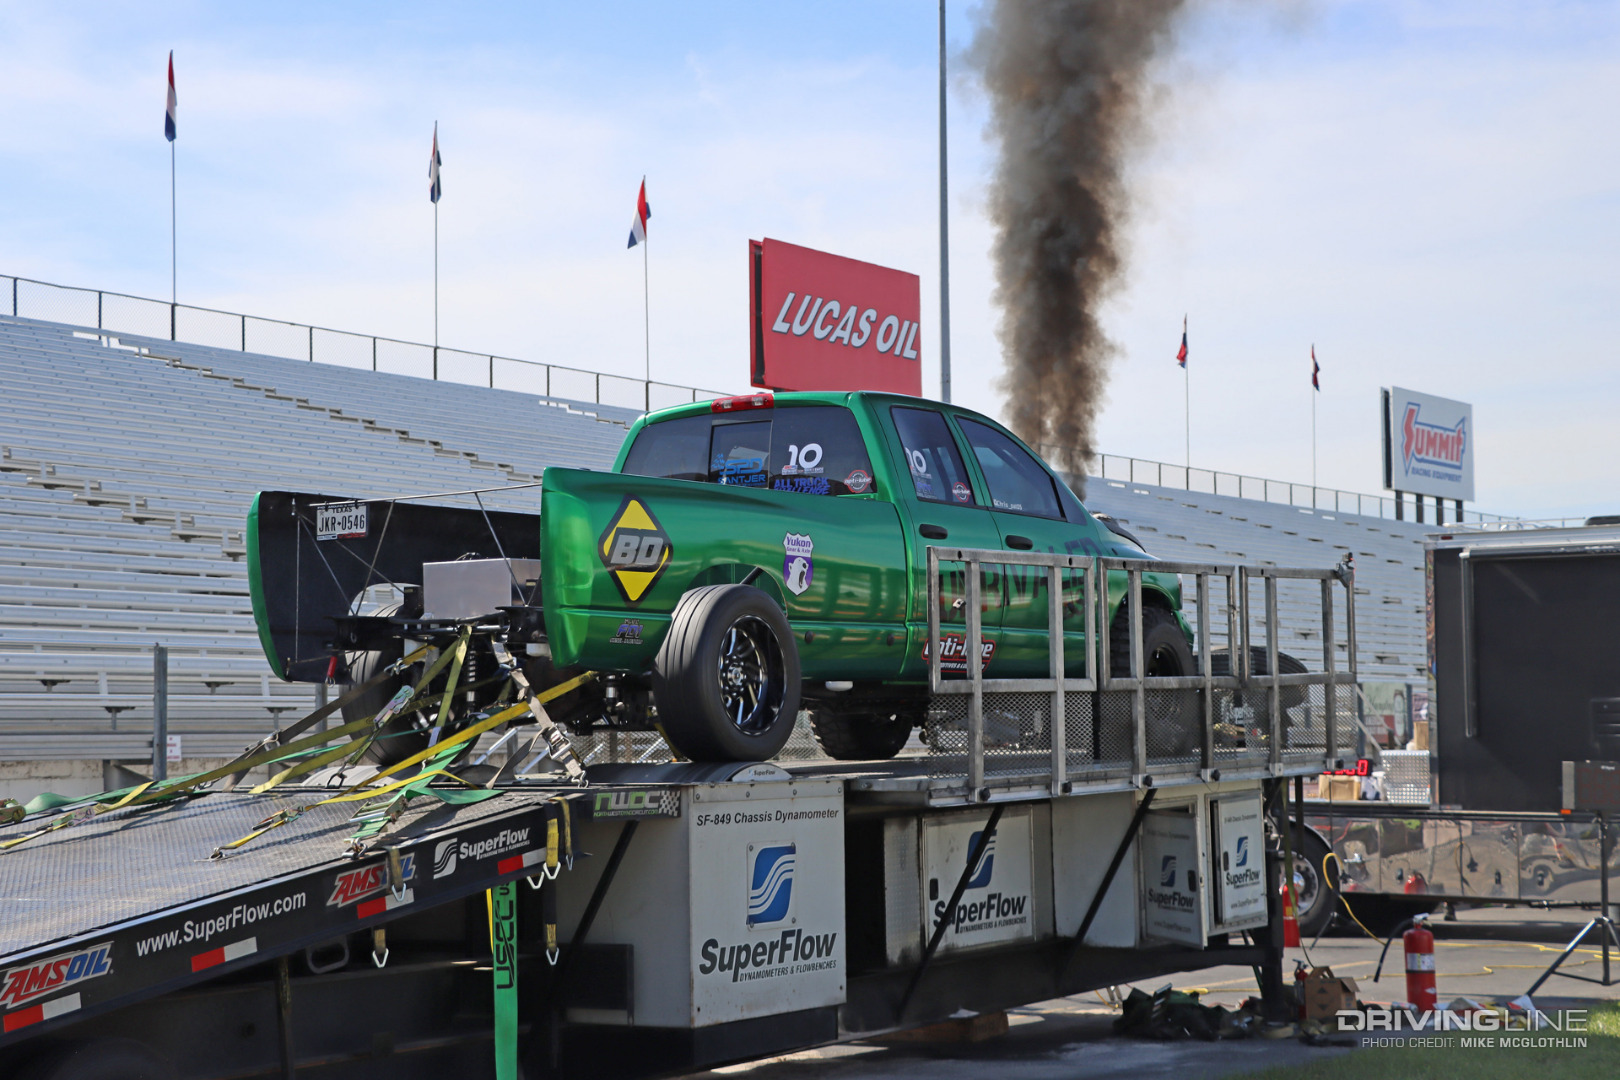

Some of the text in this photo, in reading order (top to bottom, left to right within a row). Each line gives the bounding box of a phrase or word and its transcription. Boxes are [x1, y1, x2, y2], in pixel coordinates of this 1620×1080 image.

[772, 292, 918, 360] LUCAS OIL
[1404, 407, 1464, 463] SUMMIT
[789, 443, 823, 469] 10
[775, 479, 793, 489] ALL
[793, 477, 829, 489] TRUCK
[332, 506, 353, 514] TEXAS
[610, 534, 664, 566] BD
[786, 536, 811, 548] Yukon
[697, 808, 839, 827] SF-849 Chassis Dynamometer
[460, 827, 530, 861] SuperFlow
[1226, 868, 1260, 889] SuperFlow
[1148, 888, 1194, 909] SuperFlow
[136, 892, 306, 957] www.SuperFlow.com
[699, 928, 837, 982] SuperFlow
[0, 948, 109, 1005] AMSOIL
[739, 960, 837, 982] DYNAMOMETERS & FLOWBENCHES
